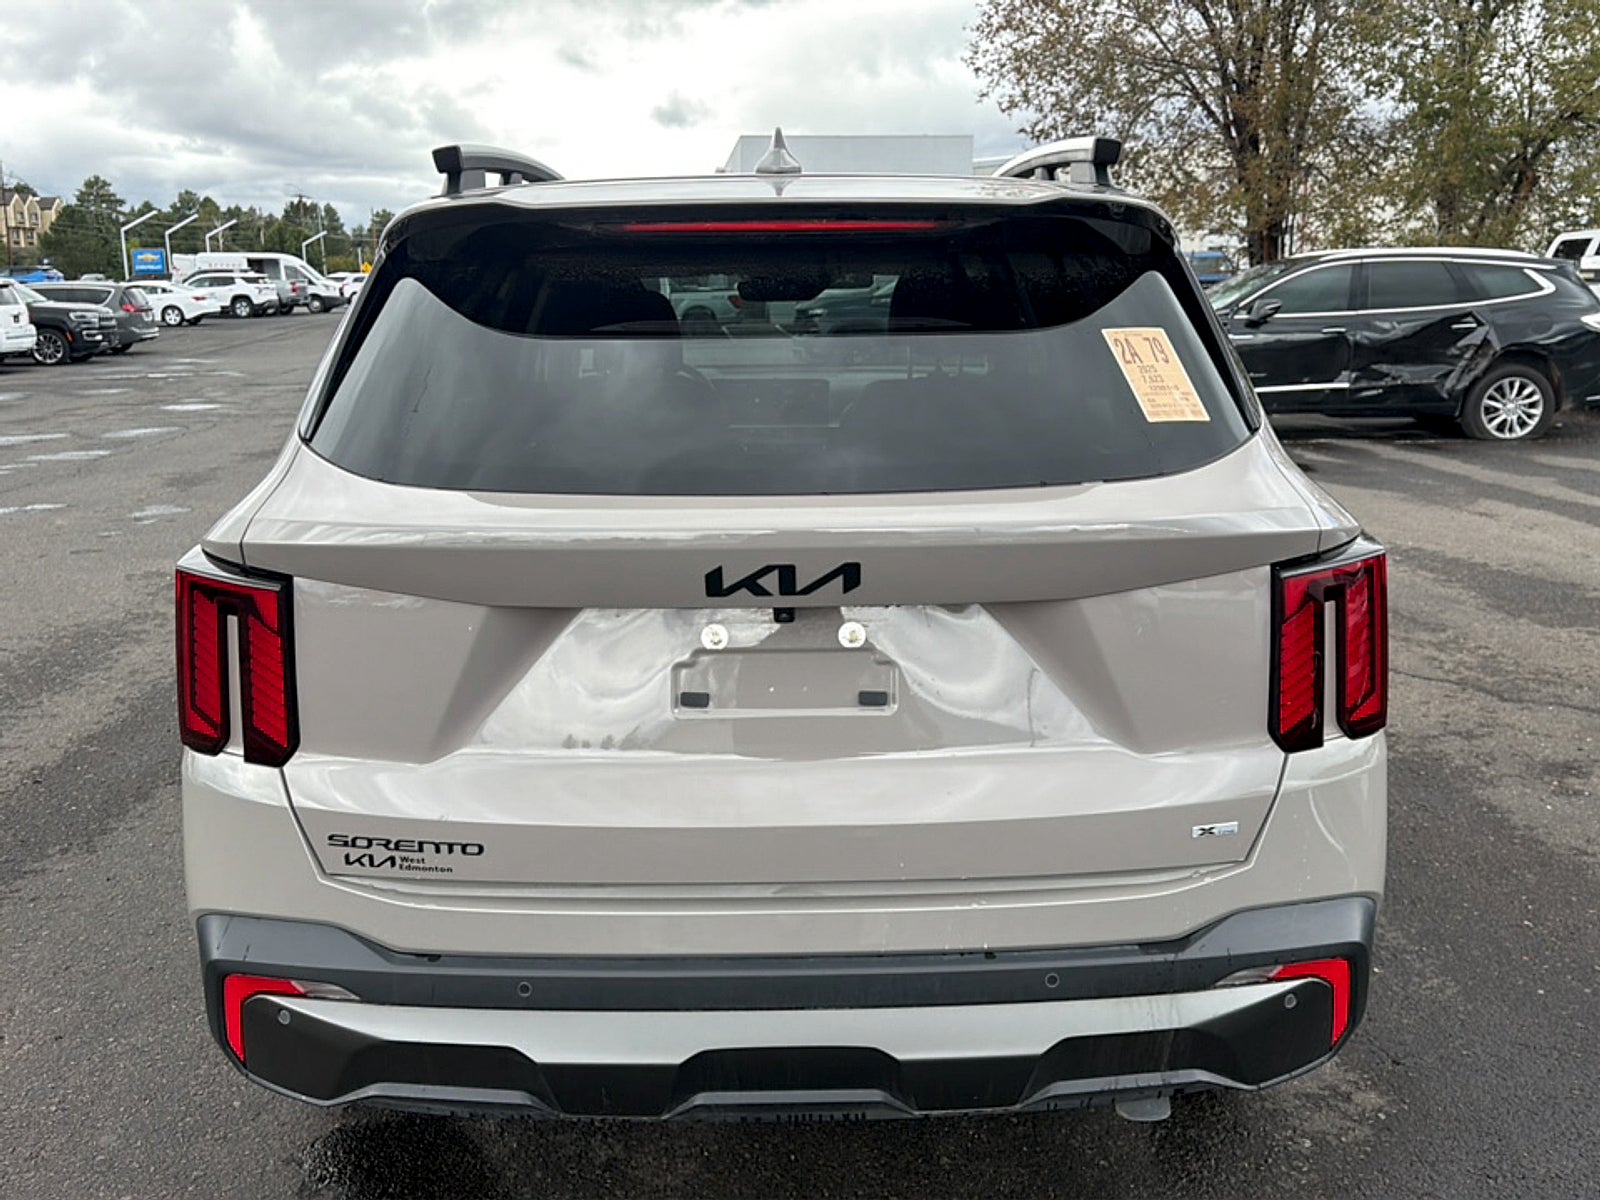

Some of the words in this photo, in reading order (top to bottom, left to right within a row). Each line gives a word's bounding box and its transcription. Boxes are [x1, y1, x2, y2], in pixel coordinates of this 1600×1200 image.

[1113, 337, 1143, 364] 2A
[1142, 336, 1169, 363] 79
[705, 562, 861, 597] KIA
[327, 833, 485, 856] SORENTO
[344, 852, 397, 868] KIA
[399, 864, 454, 873] Edmonton
[400, 856, 426, 865] West
